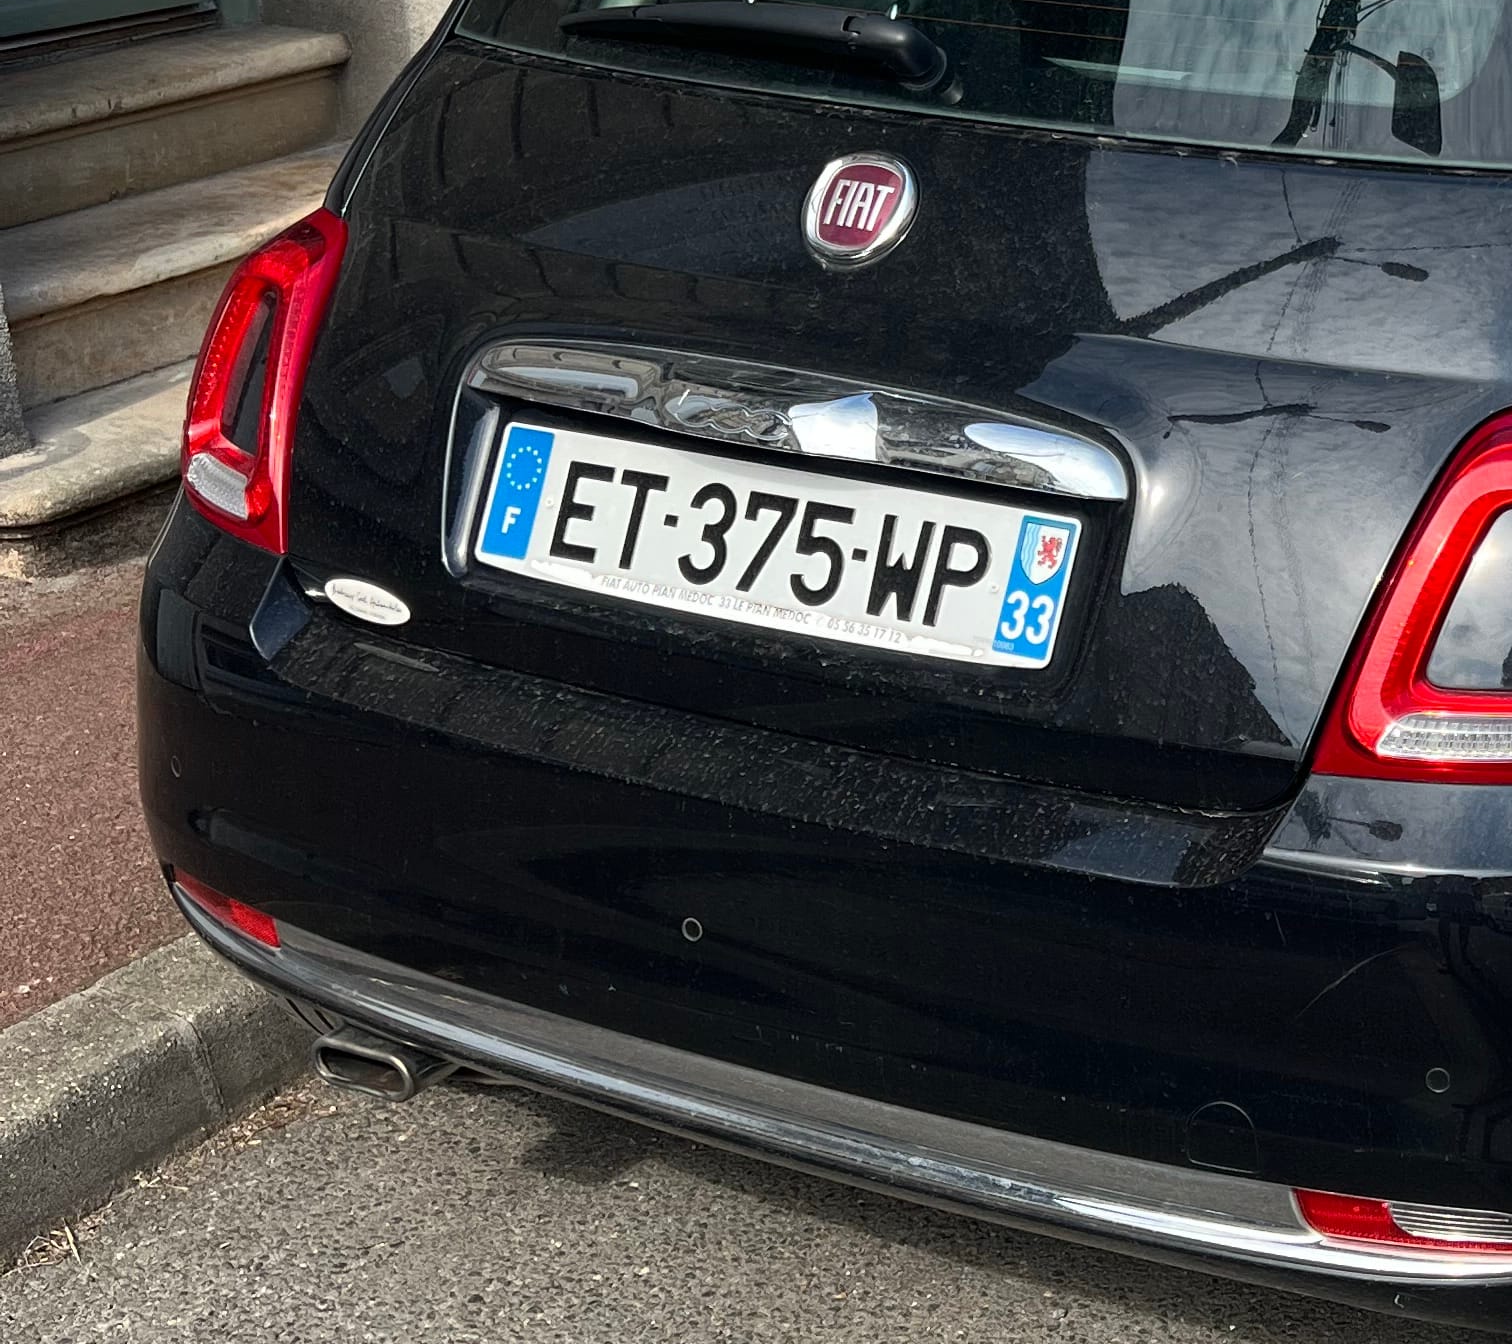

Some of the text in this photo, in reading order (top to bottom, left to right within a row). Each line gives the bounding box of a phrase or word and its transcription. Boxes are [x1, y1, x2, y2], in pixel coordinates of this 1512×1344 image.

[822, 179, 895, 232] FIAT
[501, 506, 521, 533] F
[549, 460, 992, 627] ET-375-WP
[601, 576, 621, 589] FIAT
[622, 579, 650, 594] AUTO
[1000, 590, 1055, 645] 33
